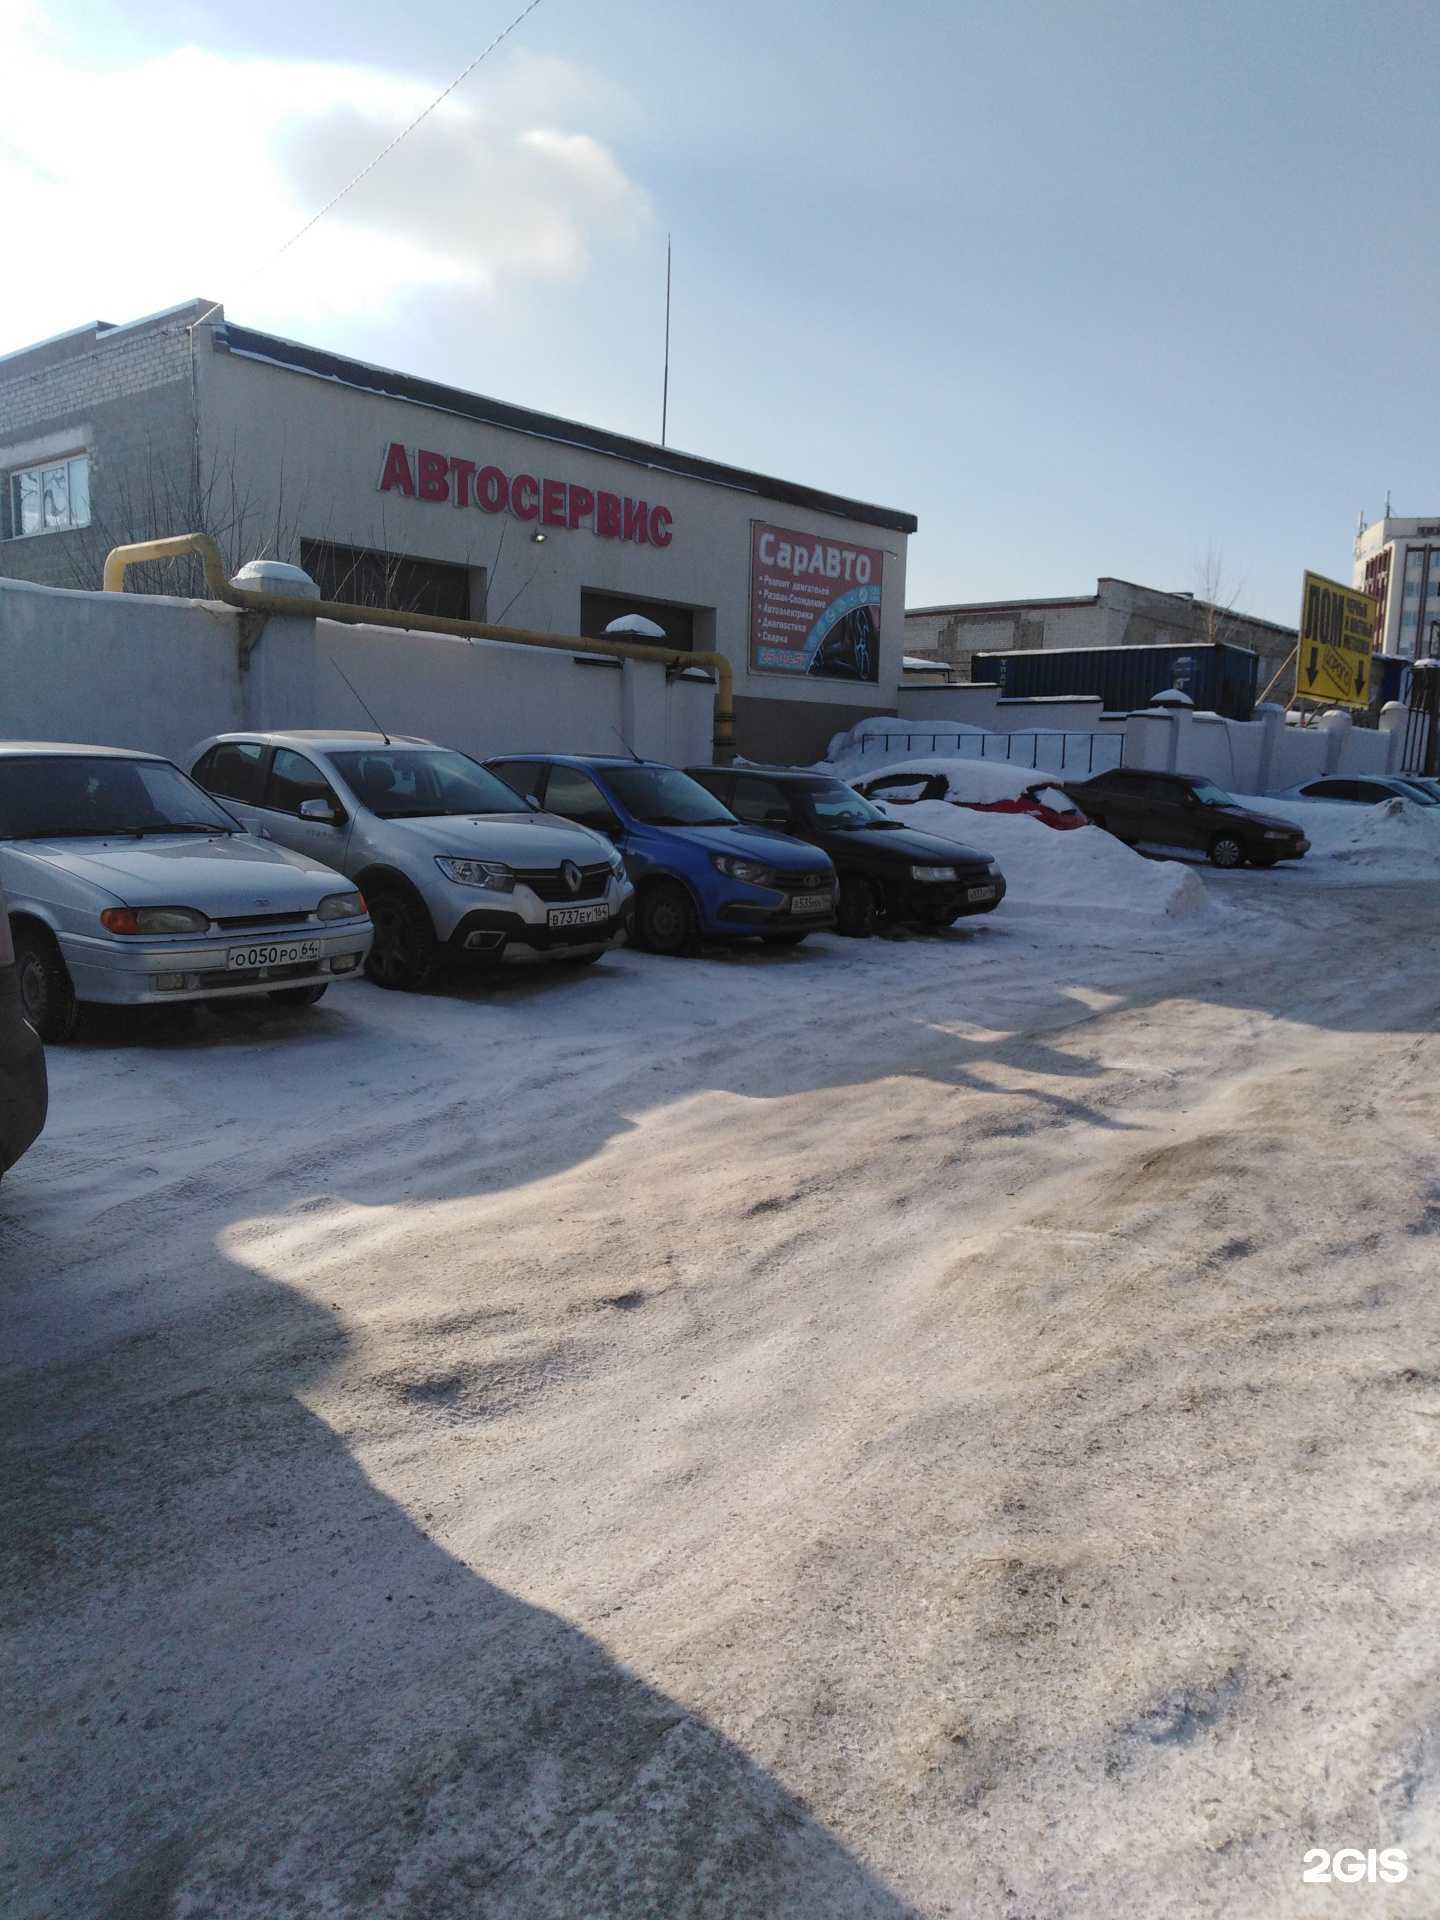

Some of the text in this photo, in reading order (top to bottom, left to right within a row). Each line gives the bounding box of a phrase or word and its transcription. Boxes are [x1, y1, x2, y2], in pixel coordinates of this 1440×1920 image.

[377, 442, 673, 547] АВТОСЕРВИС
[758, 533, 872, 584] СарАВТО
[1305, 585, 1345, 649] ЛОМ
